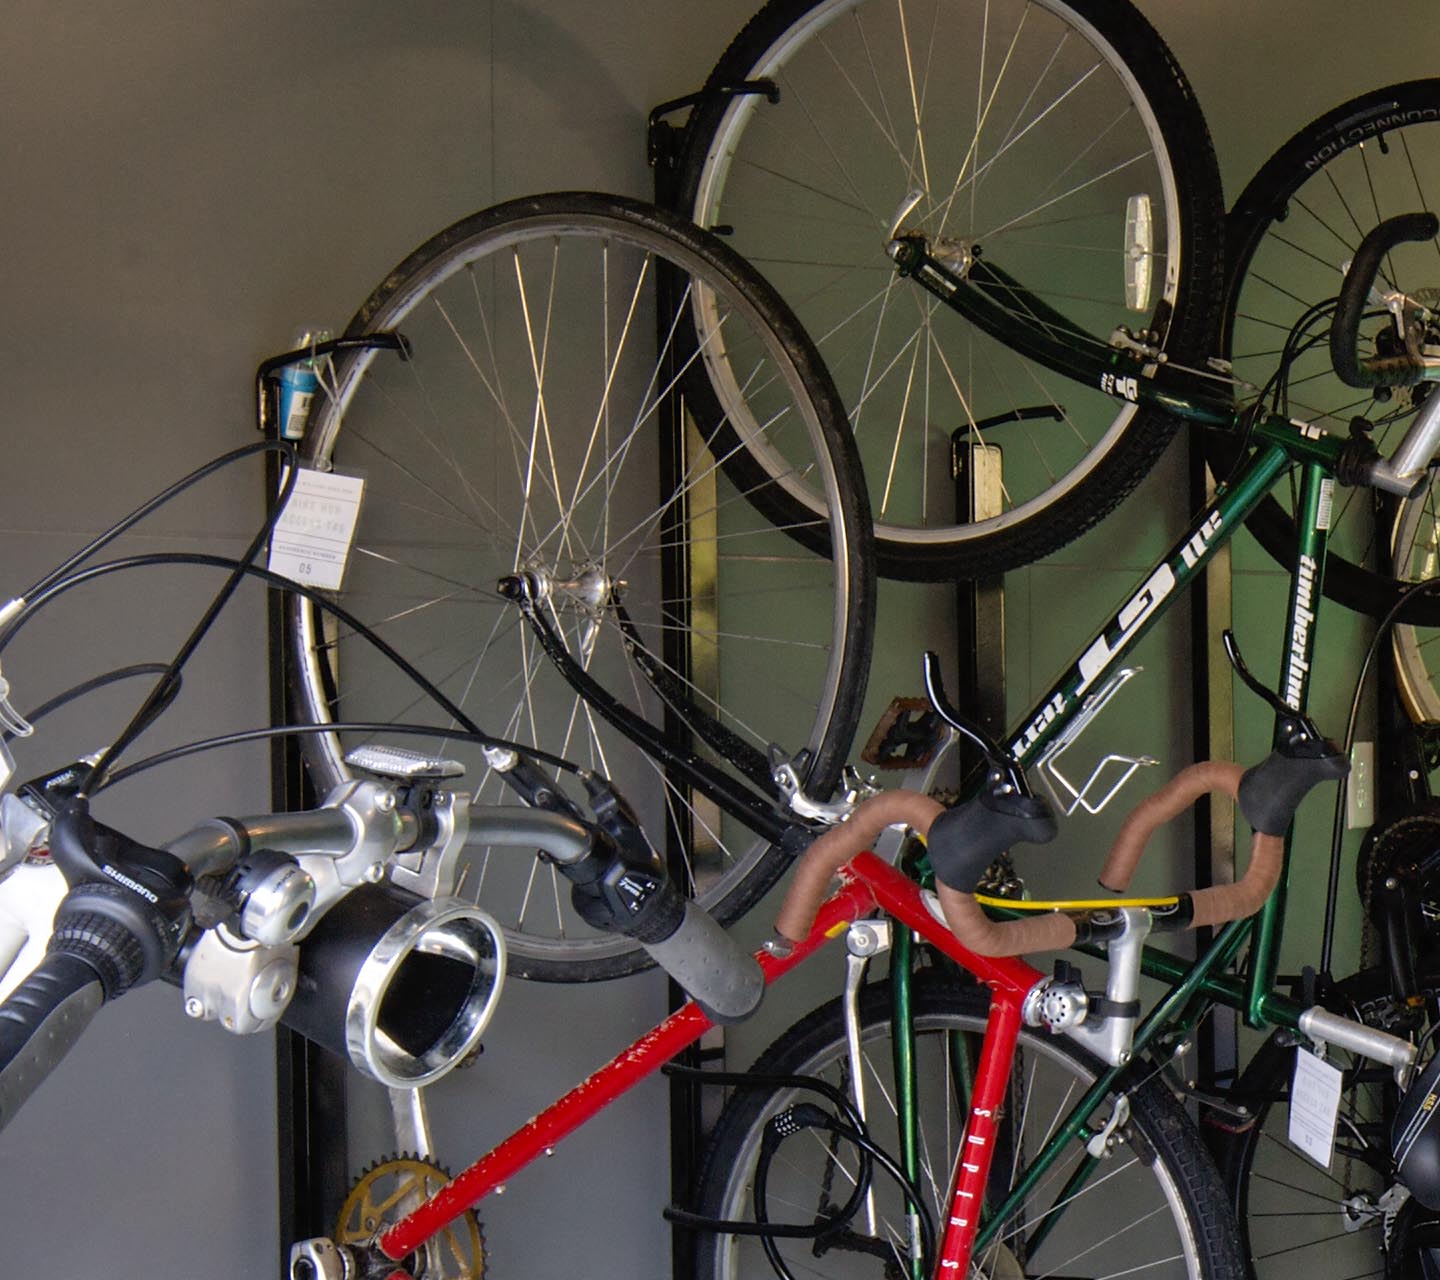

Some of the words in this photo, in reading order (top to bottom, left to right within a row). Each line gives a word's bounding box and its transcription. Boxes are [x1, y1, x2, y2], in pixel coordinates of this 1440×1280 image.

[298, 562, 313, 575] 05
[1180, 510, 1224, 569] all
[1076, 562, 1176, 697] GT
[1286, 554, 1317, 712] timberline
[1010, 693, 1068, 756] terr
[101, 863, 160, 904] SHIMANO
[950, 1107, 992, 1228] SUPER
